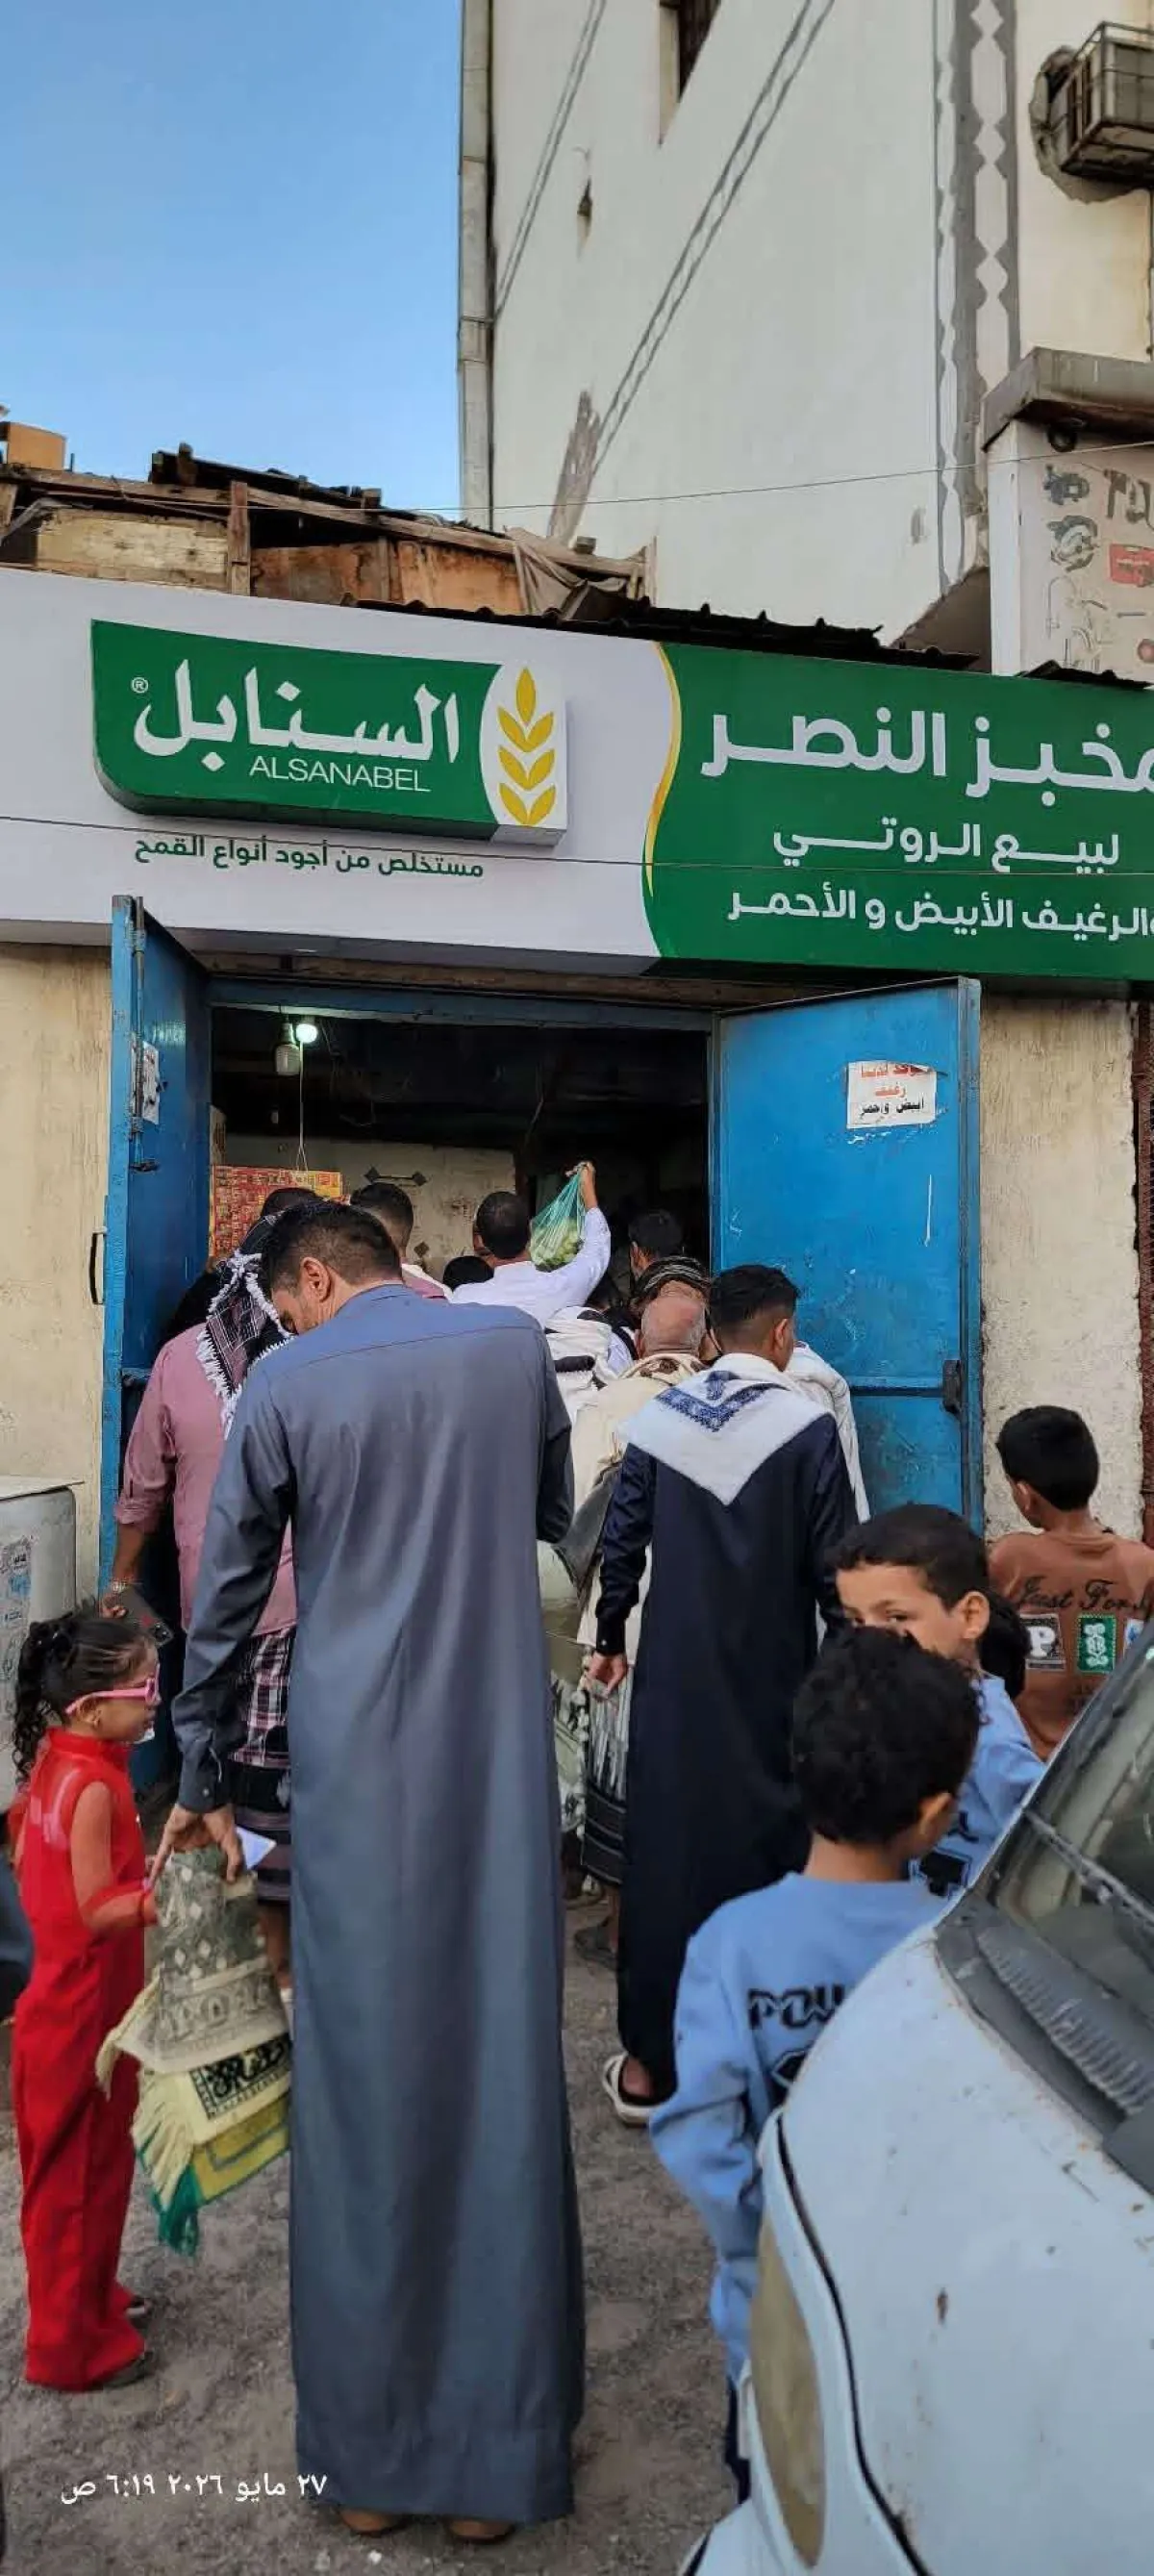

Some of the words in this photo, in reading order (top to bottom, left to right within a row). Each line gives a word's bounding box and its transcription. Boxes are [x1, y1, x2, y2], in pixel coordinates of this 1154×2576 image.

[134, 659, 460, 771] السنابل
[700, 706, 947, 777] النصر
[249, 755, 431, 793] ALSANABEL
[135, 835, 205, 863] القمح
[213, 835, 267, 869] أنواع
[275, 839, 328, 871] أجود
[336, 849, 370, 873] من
[773, 817, 981, 867] الروتي
[991, 833, 1120, 874] لبيع
[378, 852, 484, 878] مستخلص
[727, 881, 857, 922] الأحمر
[865, 897, 886, 930] و
[894, 891, 1014, 936] الأبيض
